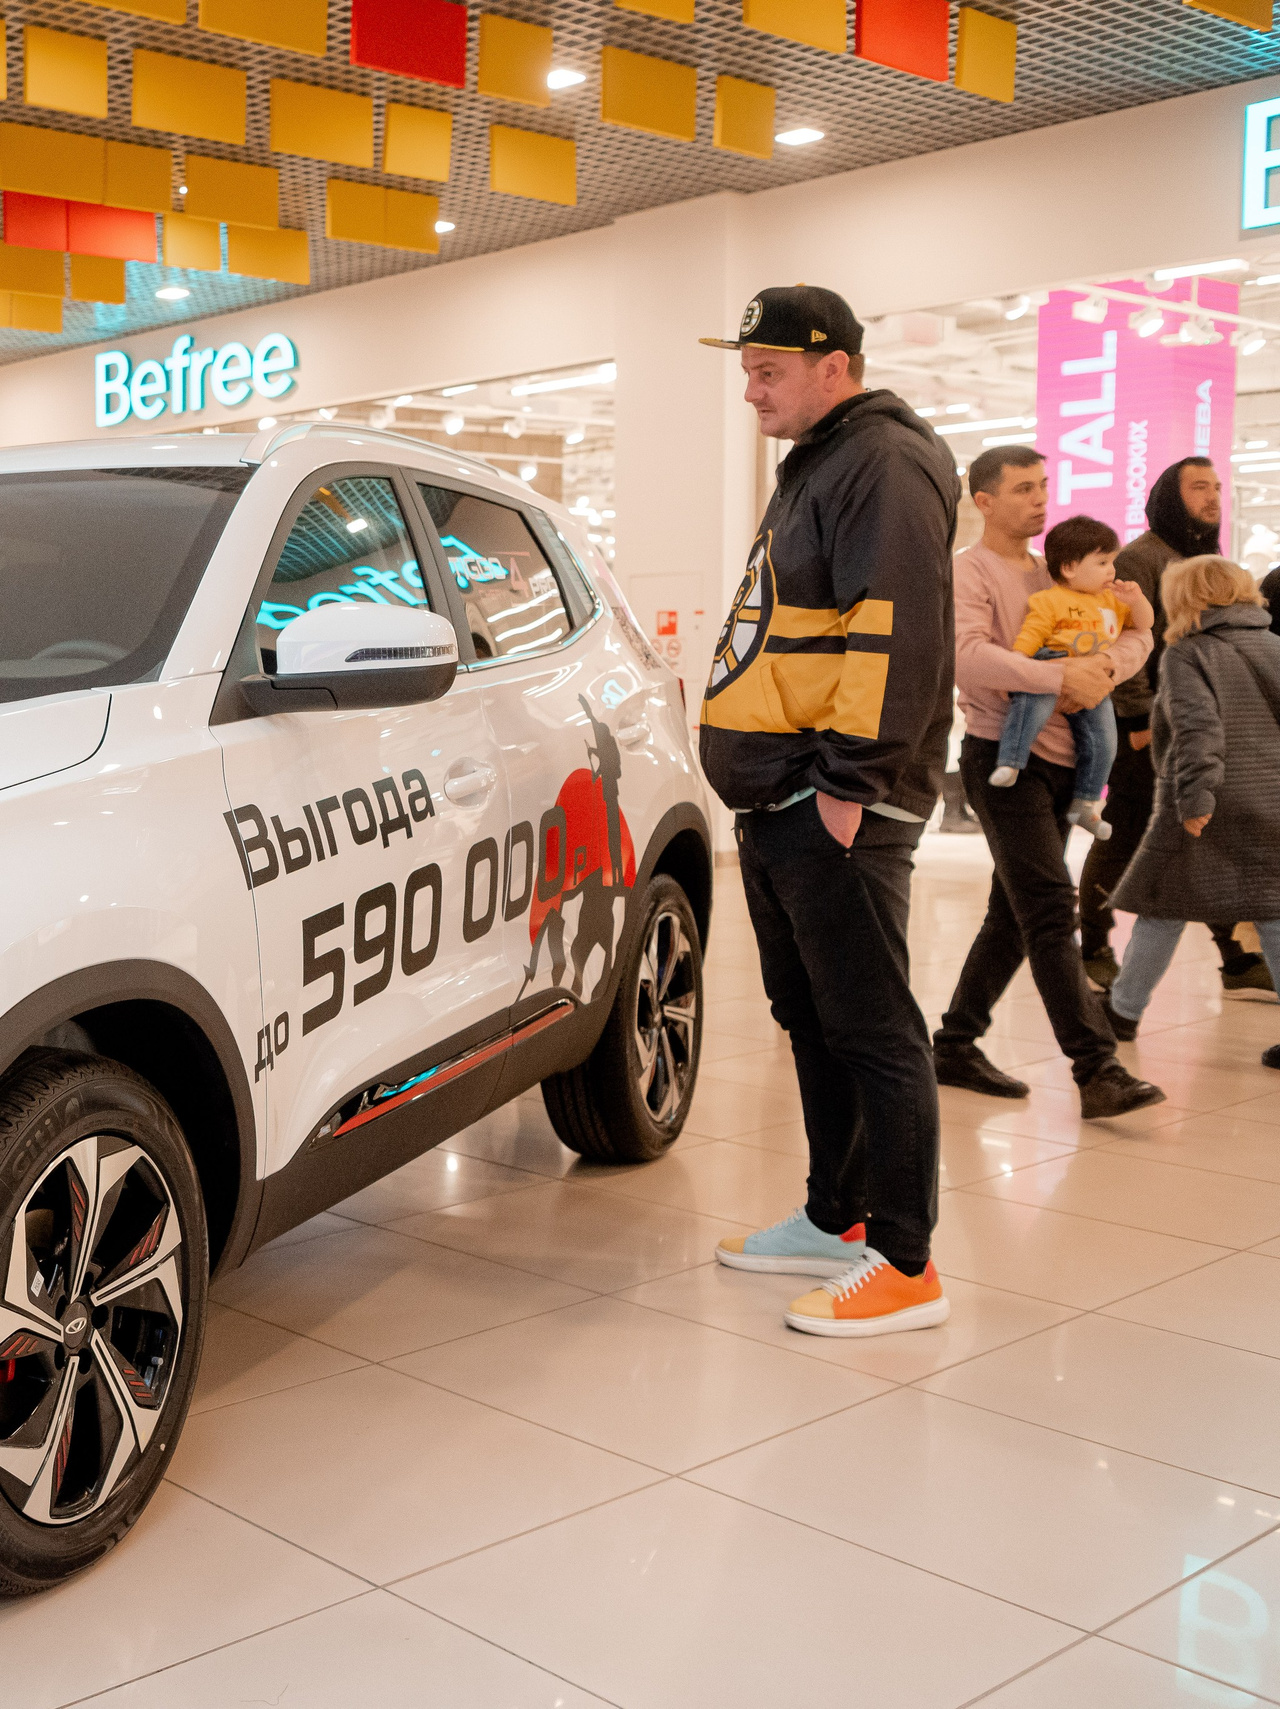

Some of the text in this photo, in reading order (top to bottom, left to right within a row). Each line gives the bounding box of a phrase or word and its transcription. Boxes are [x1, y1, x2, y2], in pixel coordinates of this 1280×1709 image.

[95, 332, 299, 428] Befree
[1057, 330, 1117, 505] TALL
[1125, 420, 1148, 525] ВЫСОКИХ
[448, 556, 506, 580] TIGGO
[223, 768, 436, 891] Выгода
[254, 1011, 290, 1084] до
[301, 862, 443, 1038] 590
[462, 804, 567, 943] 000
